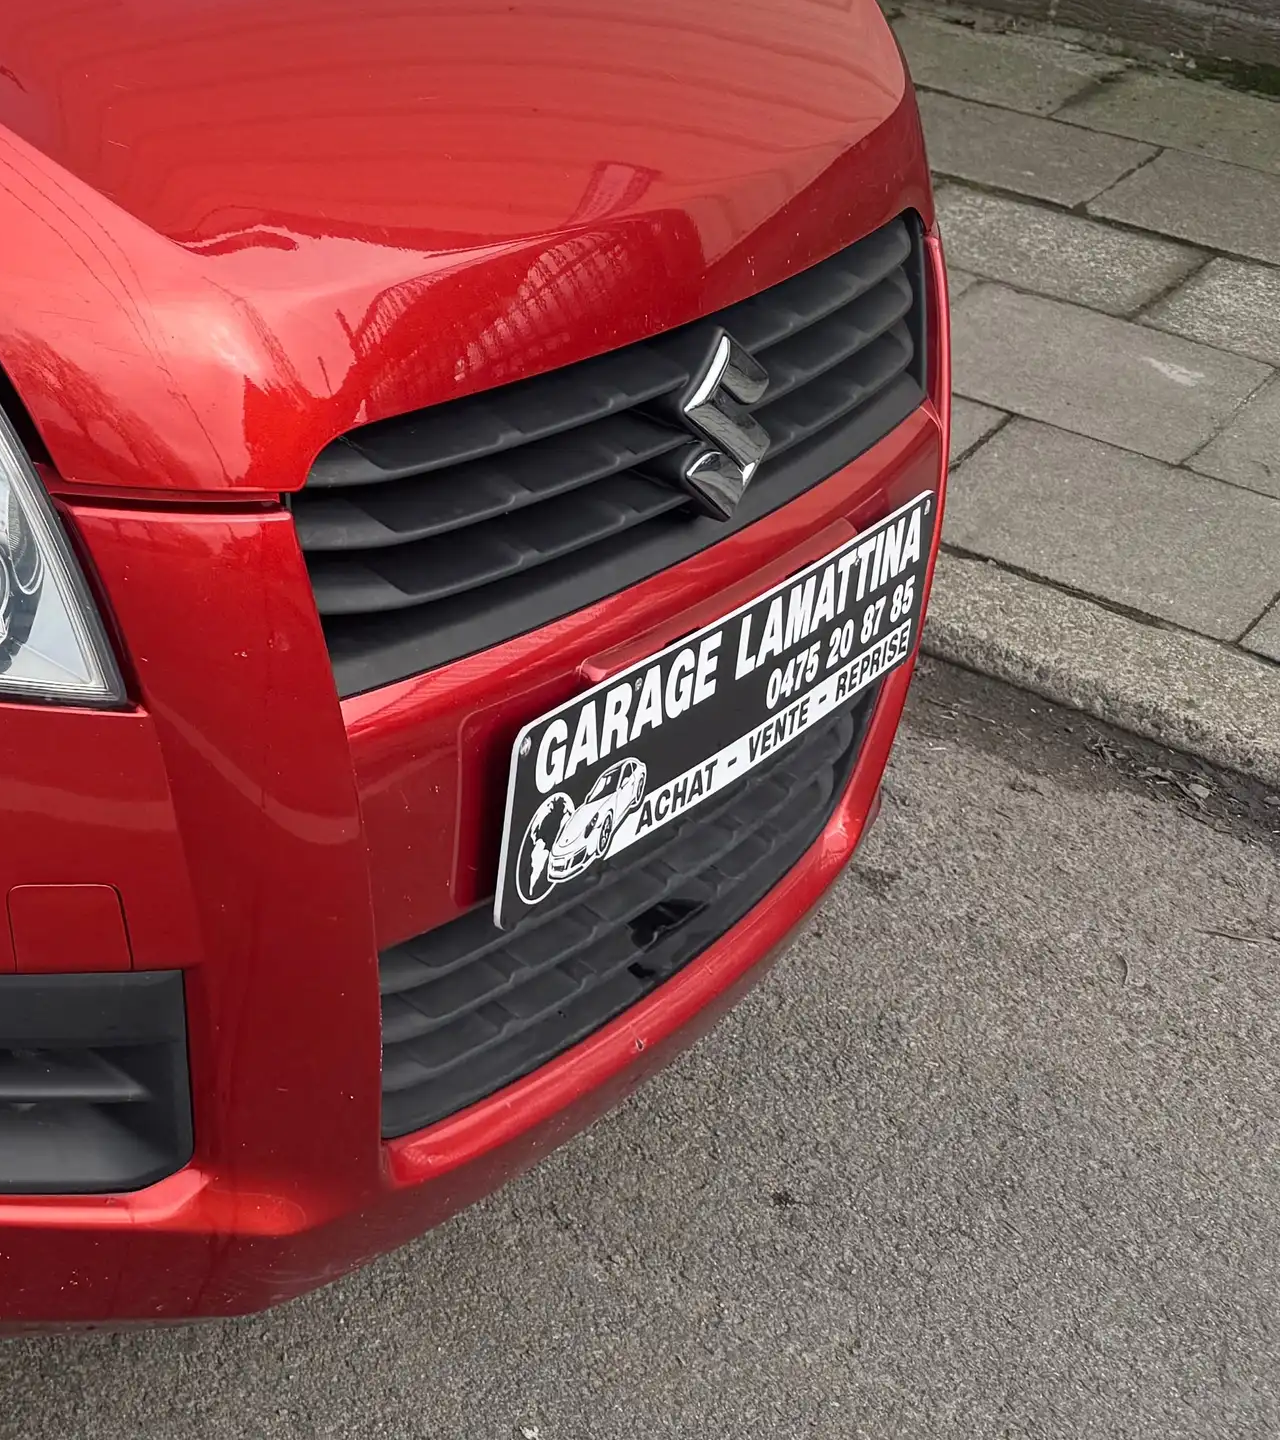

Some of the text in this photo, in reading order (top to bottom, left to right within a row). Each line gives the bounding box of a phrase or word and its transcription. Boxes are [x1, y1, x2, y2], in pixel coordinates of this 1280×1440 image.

[535, 514, 921, 794] GARAGE LAMATTINA
[637, 764, 716, 836] ACHAT
[748, 703, 810, 764] VENTE
[835, 623, 912, 702] REPRISE
[765, 576, 915, 710] 0475 20 87 85
